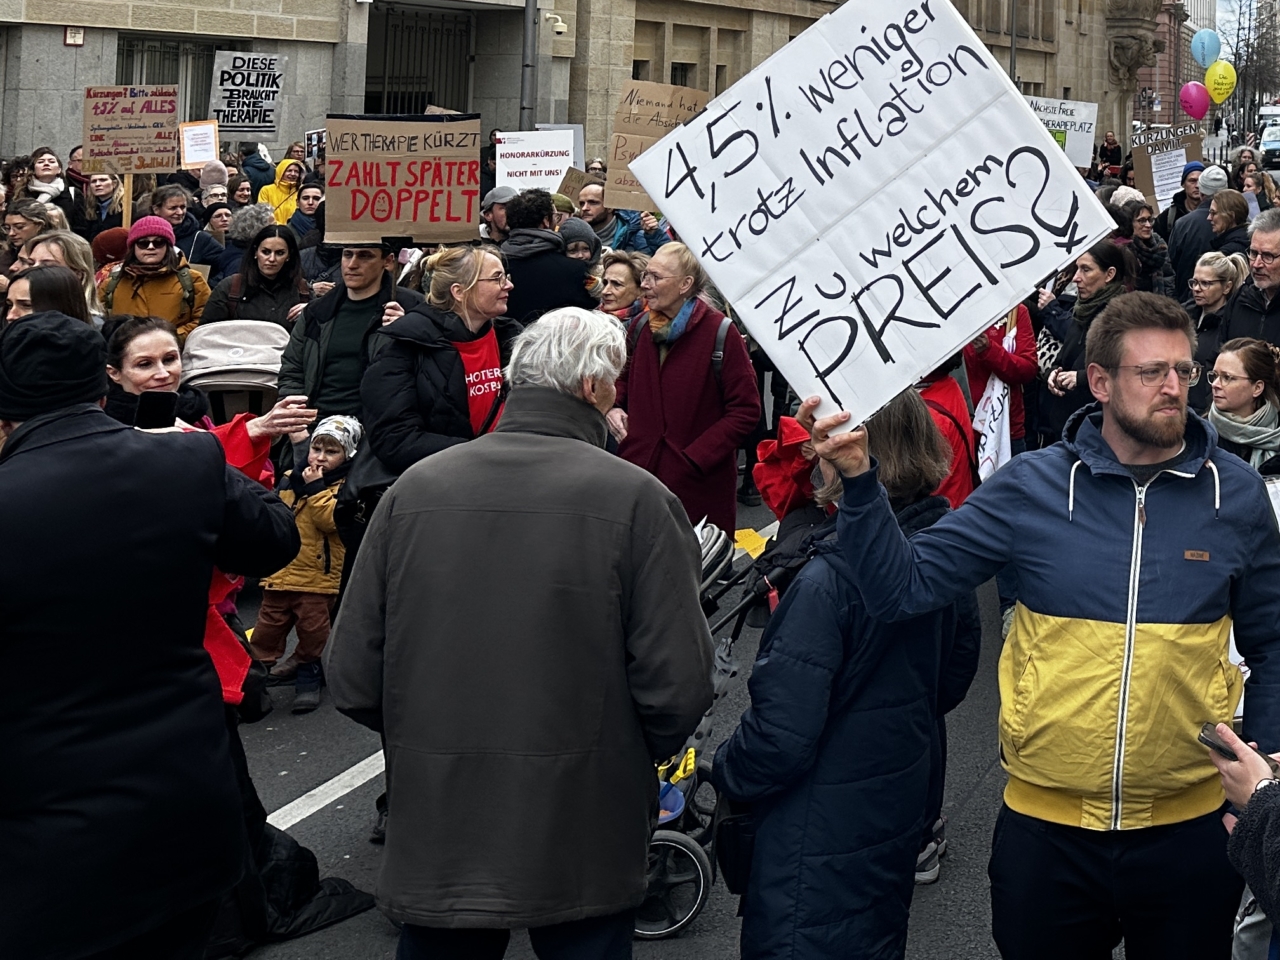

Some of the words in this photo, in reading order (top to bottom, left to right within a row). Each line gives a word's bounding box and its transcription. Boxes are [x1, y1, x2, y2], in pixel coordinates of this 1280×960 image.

[231, 56, 278, 71] DIESE
[219, 70, 283, 89] POLITIK
[222, 88, 278, 101] BRAUCHT
[622, 88, 674, 109] Niemand
[679, 96, 699, 114] hat
[139, 99, 176, 114] ALLES
[226, 100, 264, 109] EINE
[213, 108, 274, 124] THERAPIE
[622, 110, 641, 125] die
[646, 111, 687, 128] Absich
[328, 131, 360, 152] WER
[360, 132, 419, 153] THERAPIE
[423, 130, 481, 151] KÜRZT
[499, 149, 571, 160] HONORARKÜRZUNG
[701, 176, 805, 262] trotz
[799, 43, 989, 186] Inflation
[327, 159, 402, 188] ZAHLT
[404, 156, 480, 188] SPÄTER
[506, 170, 528, 178] NICHT
[529, 169, 544, 178] MIT
[544, 169, 563, 177] UNS!
[350, 188, 480, 224] DOPPELT
[858, 152, 1005, 269] welchem
